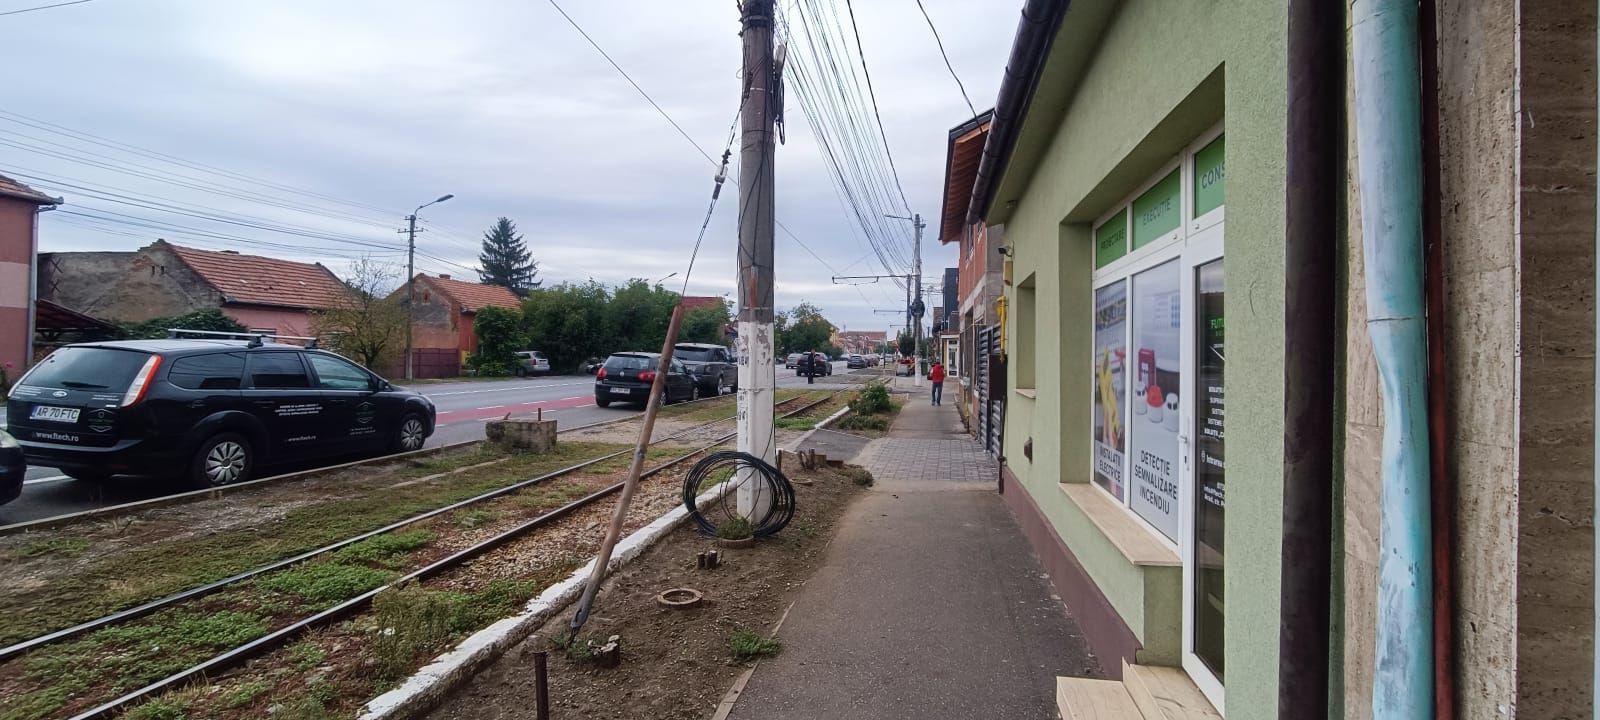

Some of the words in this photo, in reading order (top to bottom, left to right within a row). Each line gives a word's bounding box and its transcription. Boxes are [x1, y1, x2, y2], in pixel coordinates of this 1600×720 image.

[37, 407, 48, 416] AR
[49, 408, 60, 418] 70
[61, 409, 78, 419] FTC
[36, 431, 79, 442] www.ftech.ro
[1099, 459, 1121, 482] ELECTRICE
[1141, 450, 1170, 476] DETECȚIE
[1134, 464, 1177, 500] SEMNALIZARE
[1140, 485, 1170, 515] INCENDIU
